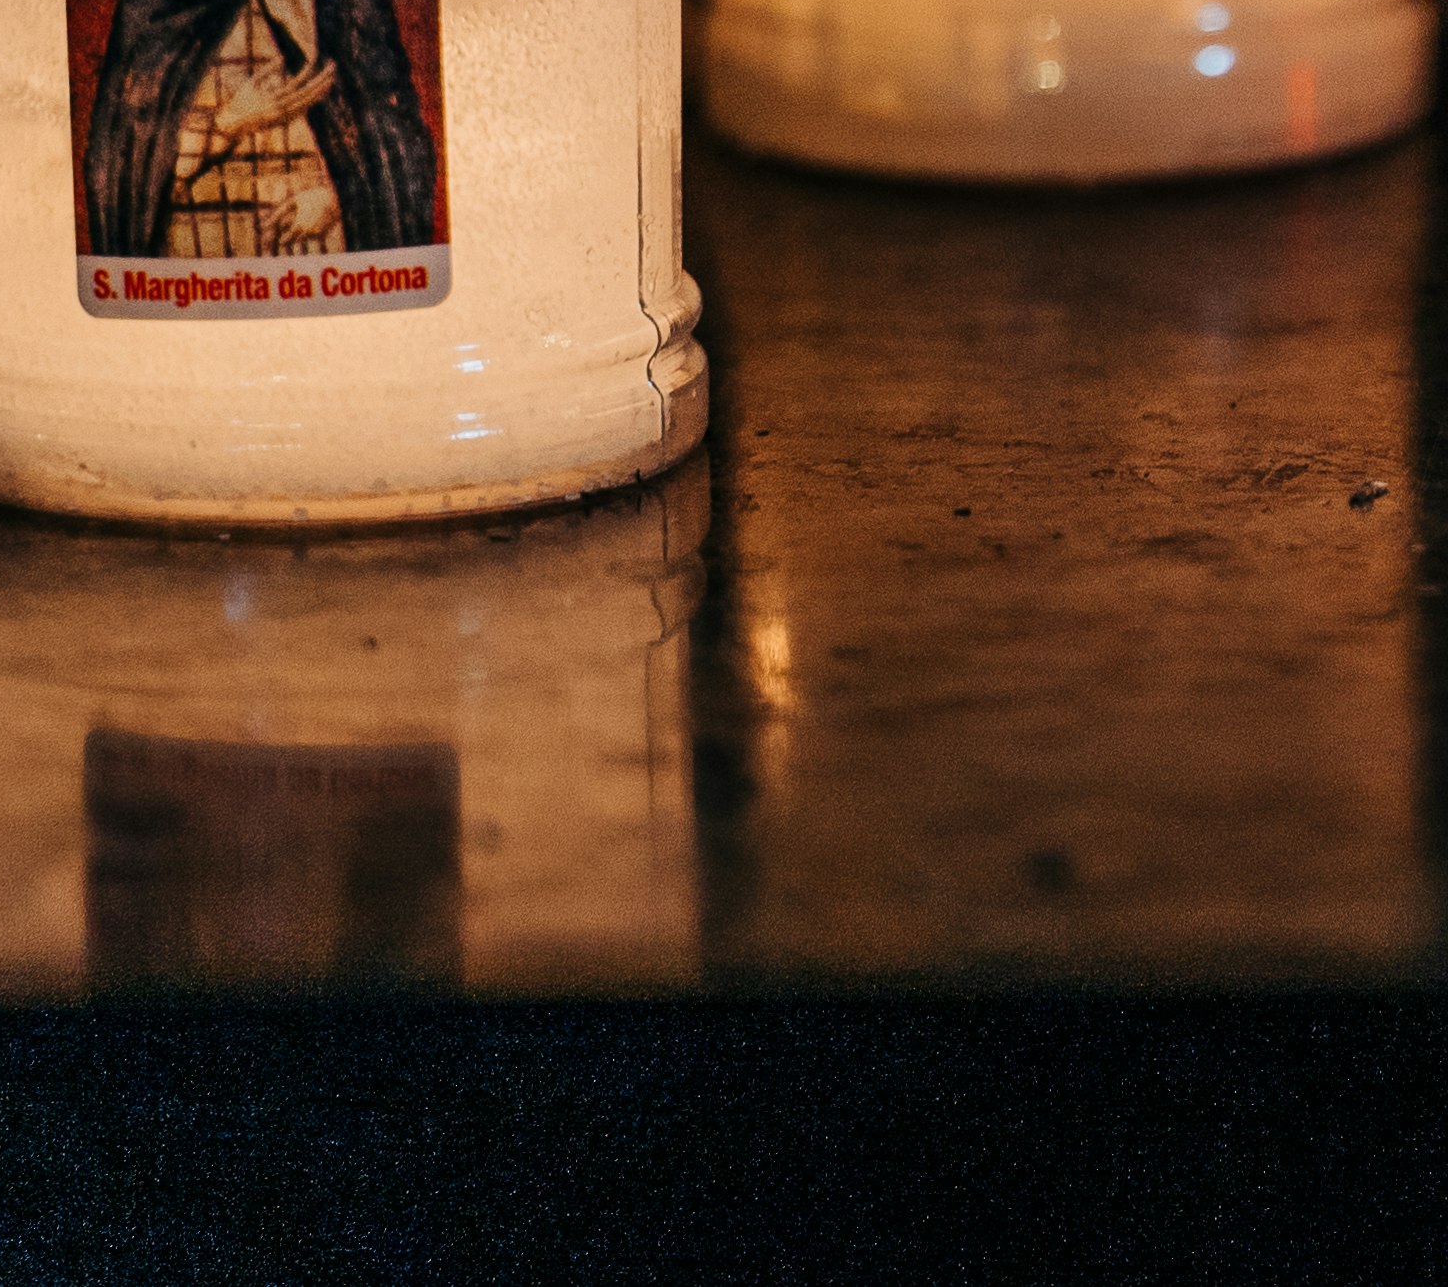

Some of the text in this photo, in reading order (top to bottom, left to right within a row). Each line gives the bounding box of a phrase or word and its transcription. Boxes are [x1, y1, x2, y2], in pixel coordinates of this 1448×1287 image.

[93, 265, 428, 308] S. Margherita da Cortona
